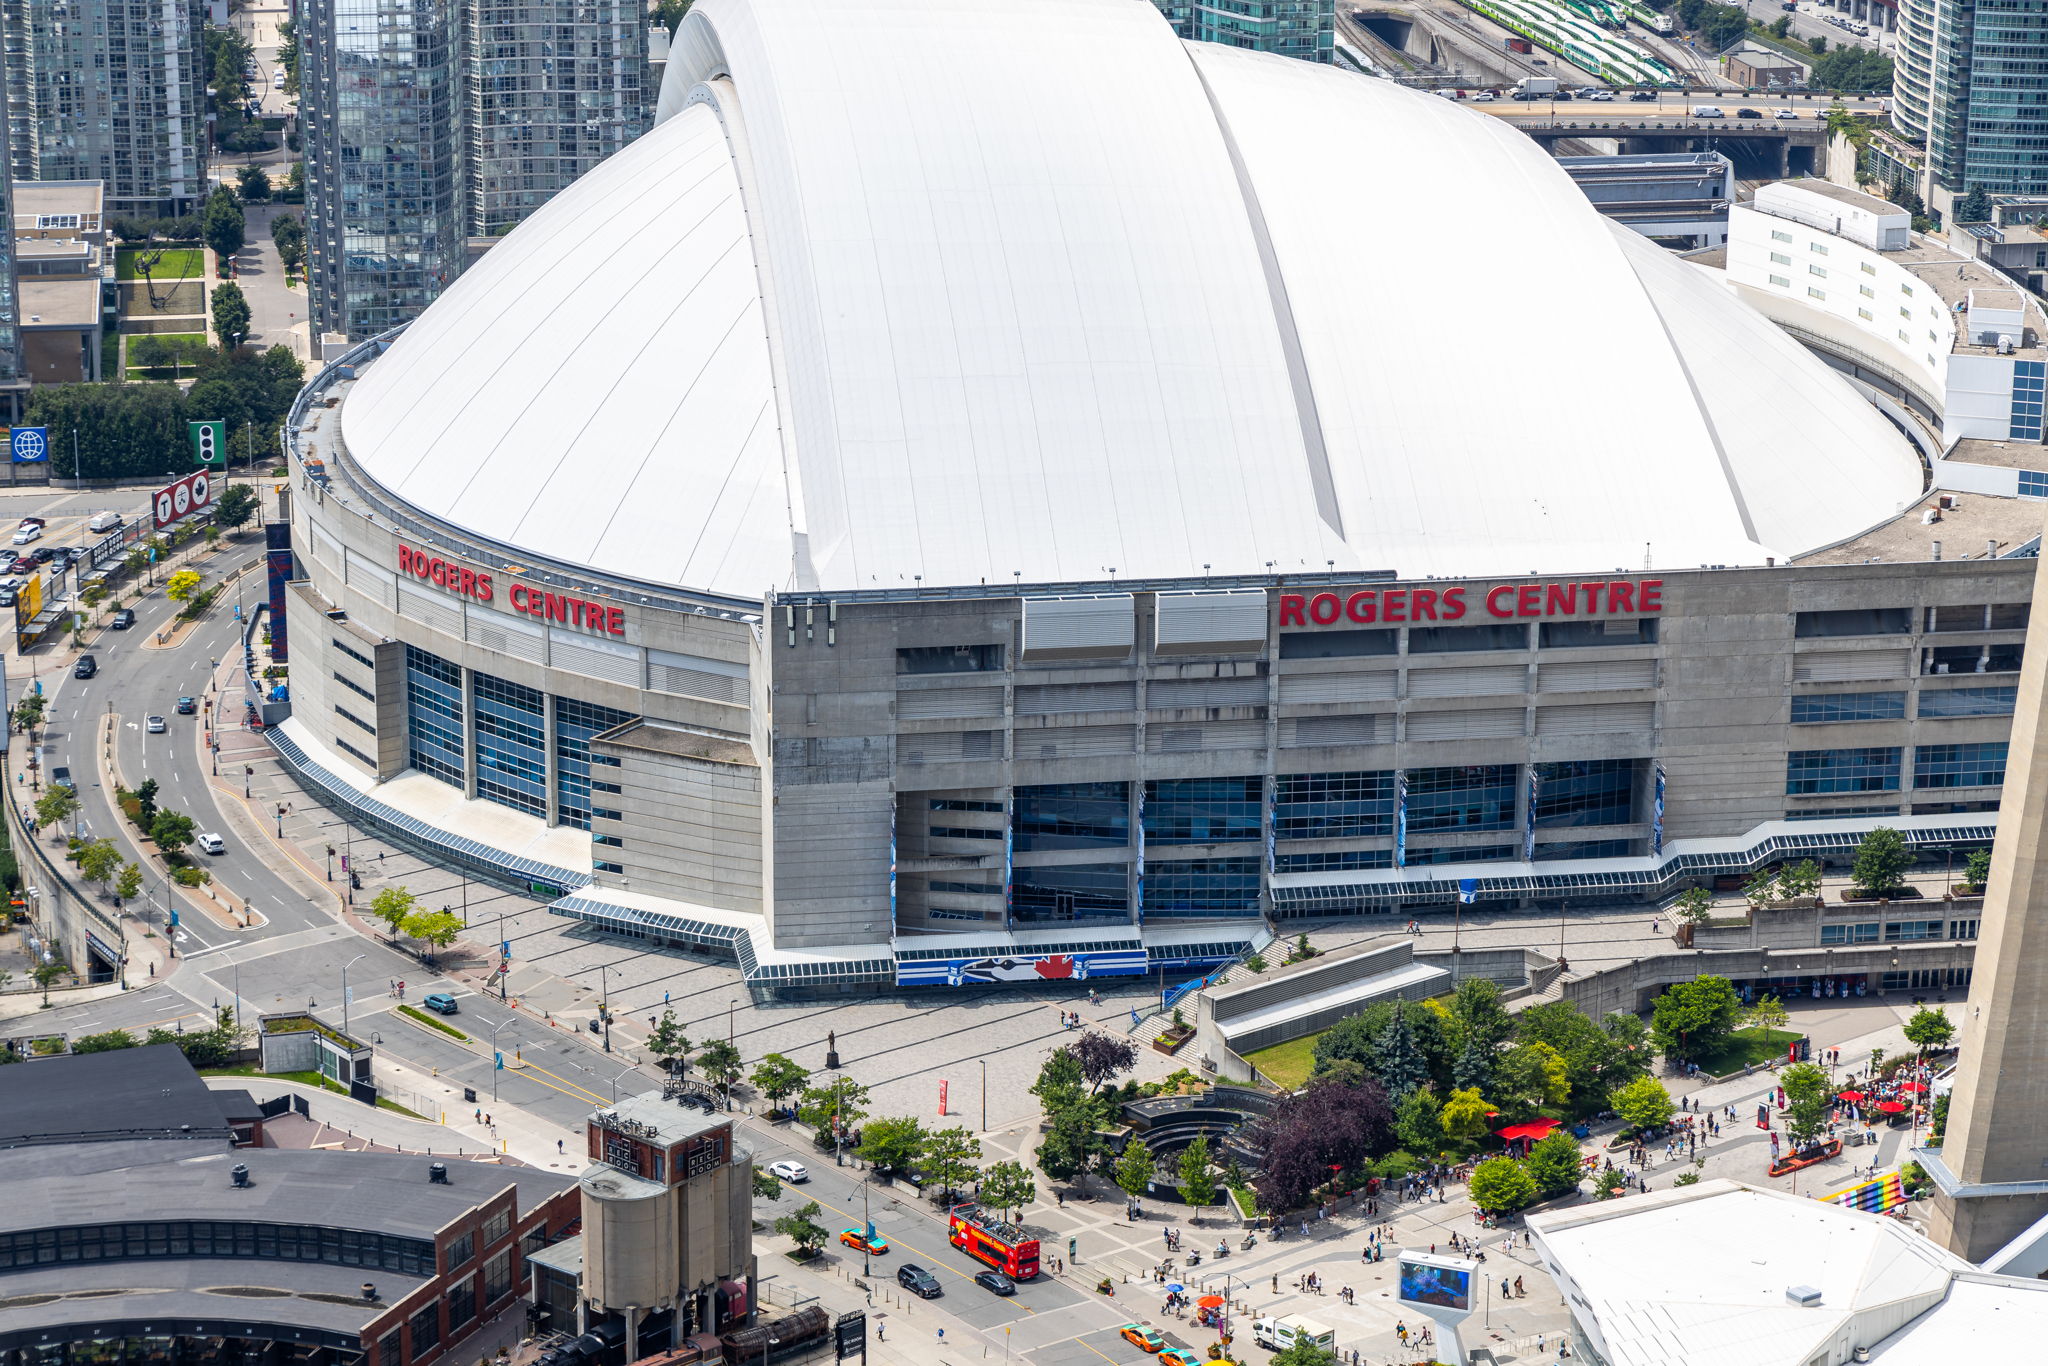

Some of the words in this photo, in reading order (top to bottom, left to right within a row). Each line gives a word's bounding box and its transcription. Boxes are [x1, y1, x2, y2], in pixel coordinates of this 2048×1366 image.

[398, 543, 493, 601] ROGERS
[509, 582, 625, 636] CENTRE
[1280, 587, 1467, 627] ROGERS
[1485, 580, 1663, 618] CENTRE
[608, 1146, 629, 1159] REC
[691, 1153, 712, 1166] REC
[608, 1157, 637, 1172] ROOM
[691, 1160, 720, 1176] ROOM
